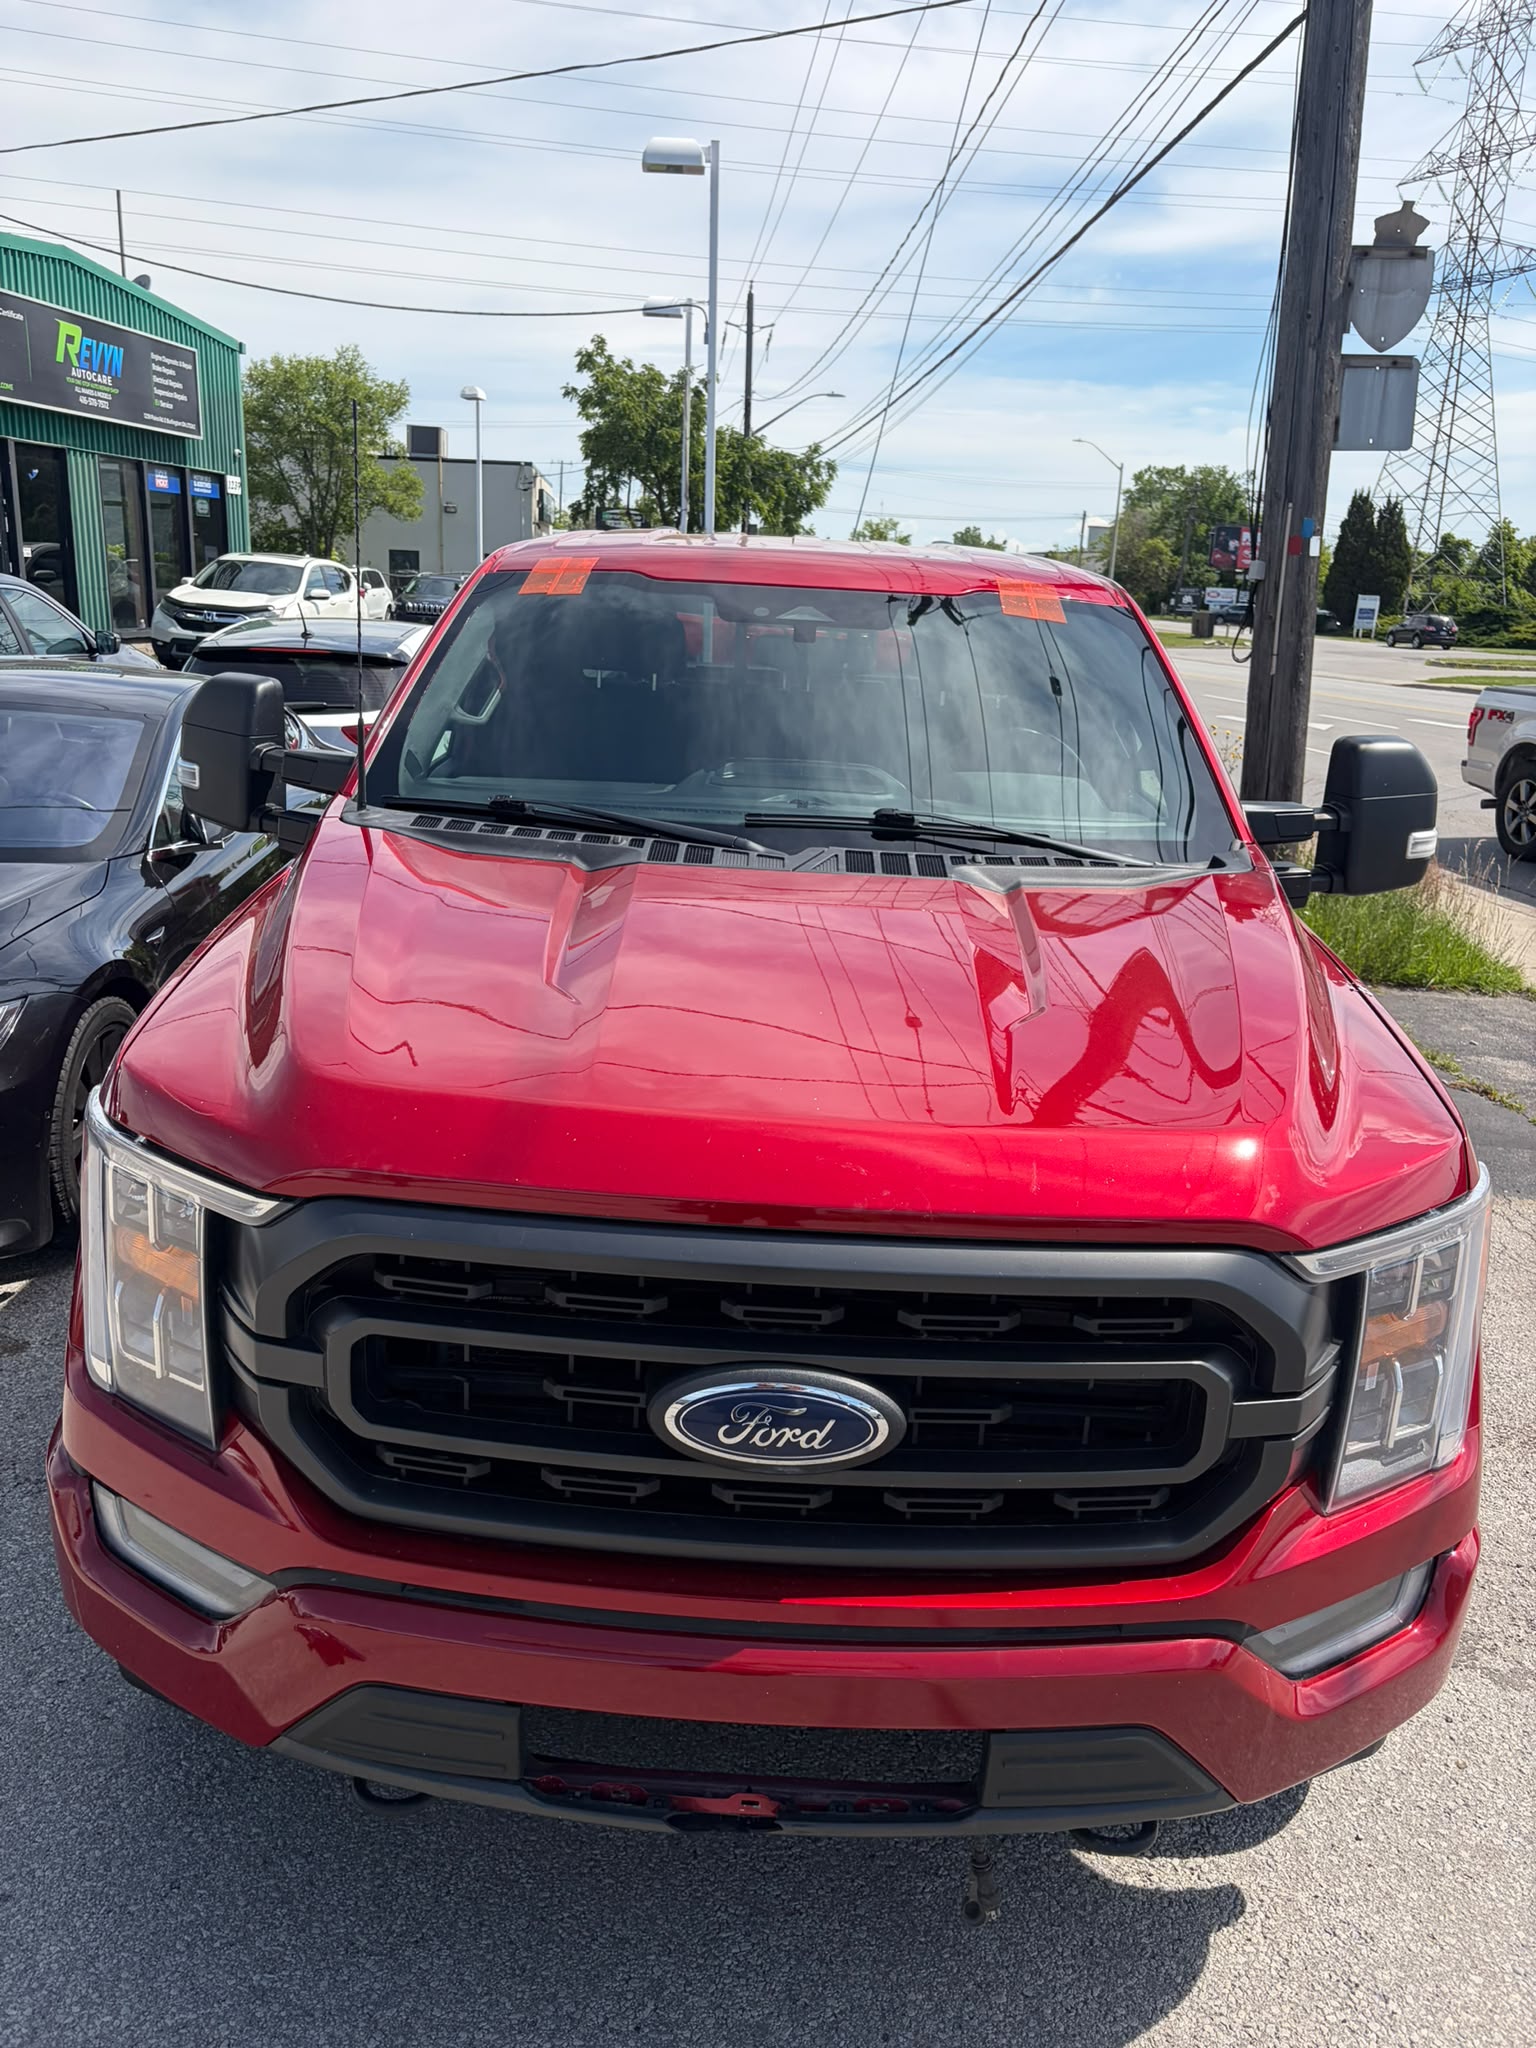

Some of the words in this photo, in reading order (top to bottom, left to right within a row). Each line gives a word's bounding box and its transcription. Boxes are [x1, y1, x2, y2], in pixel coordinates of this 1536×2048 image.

[55, 318, 124, 378] REVYN
[71, 367, 113, 386] AUTOCARE
[1488, 709, 1515, 721] FX4
[717, 1401, 836, 1449] Ford
